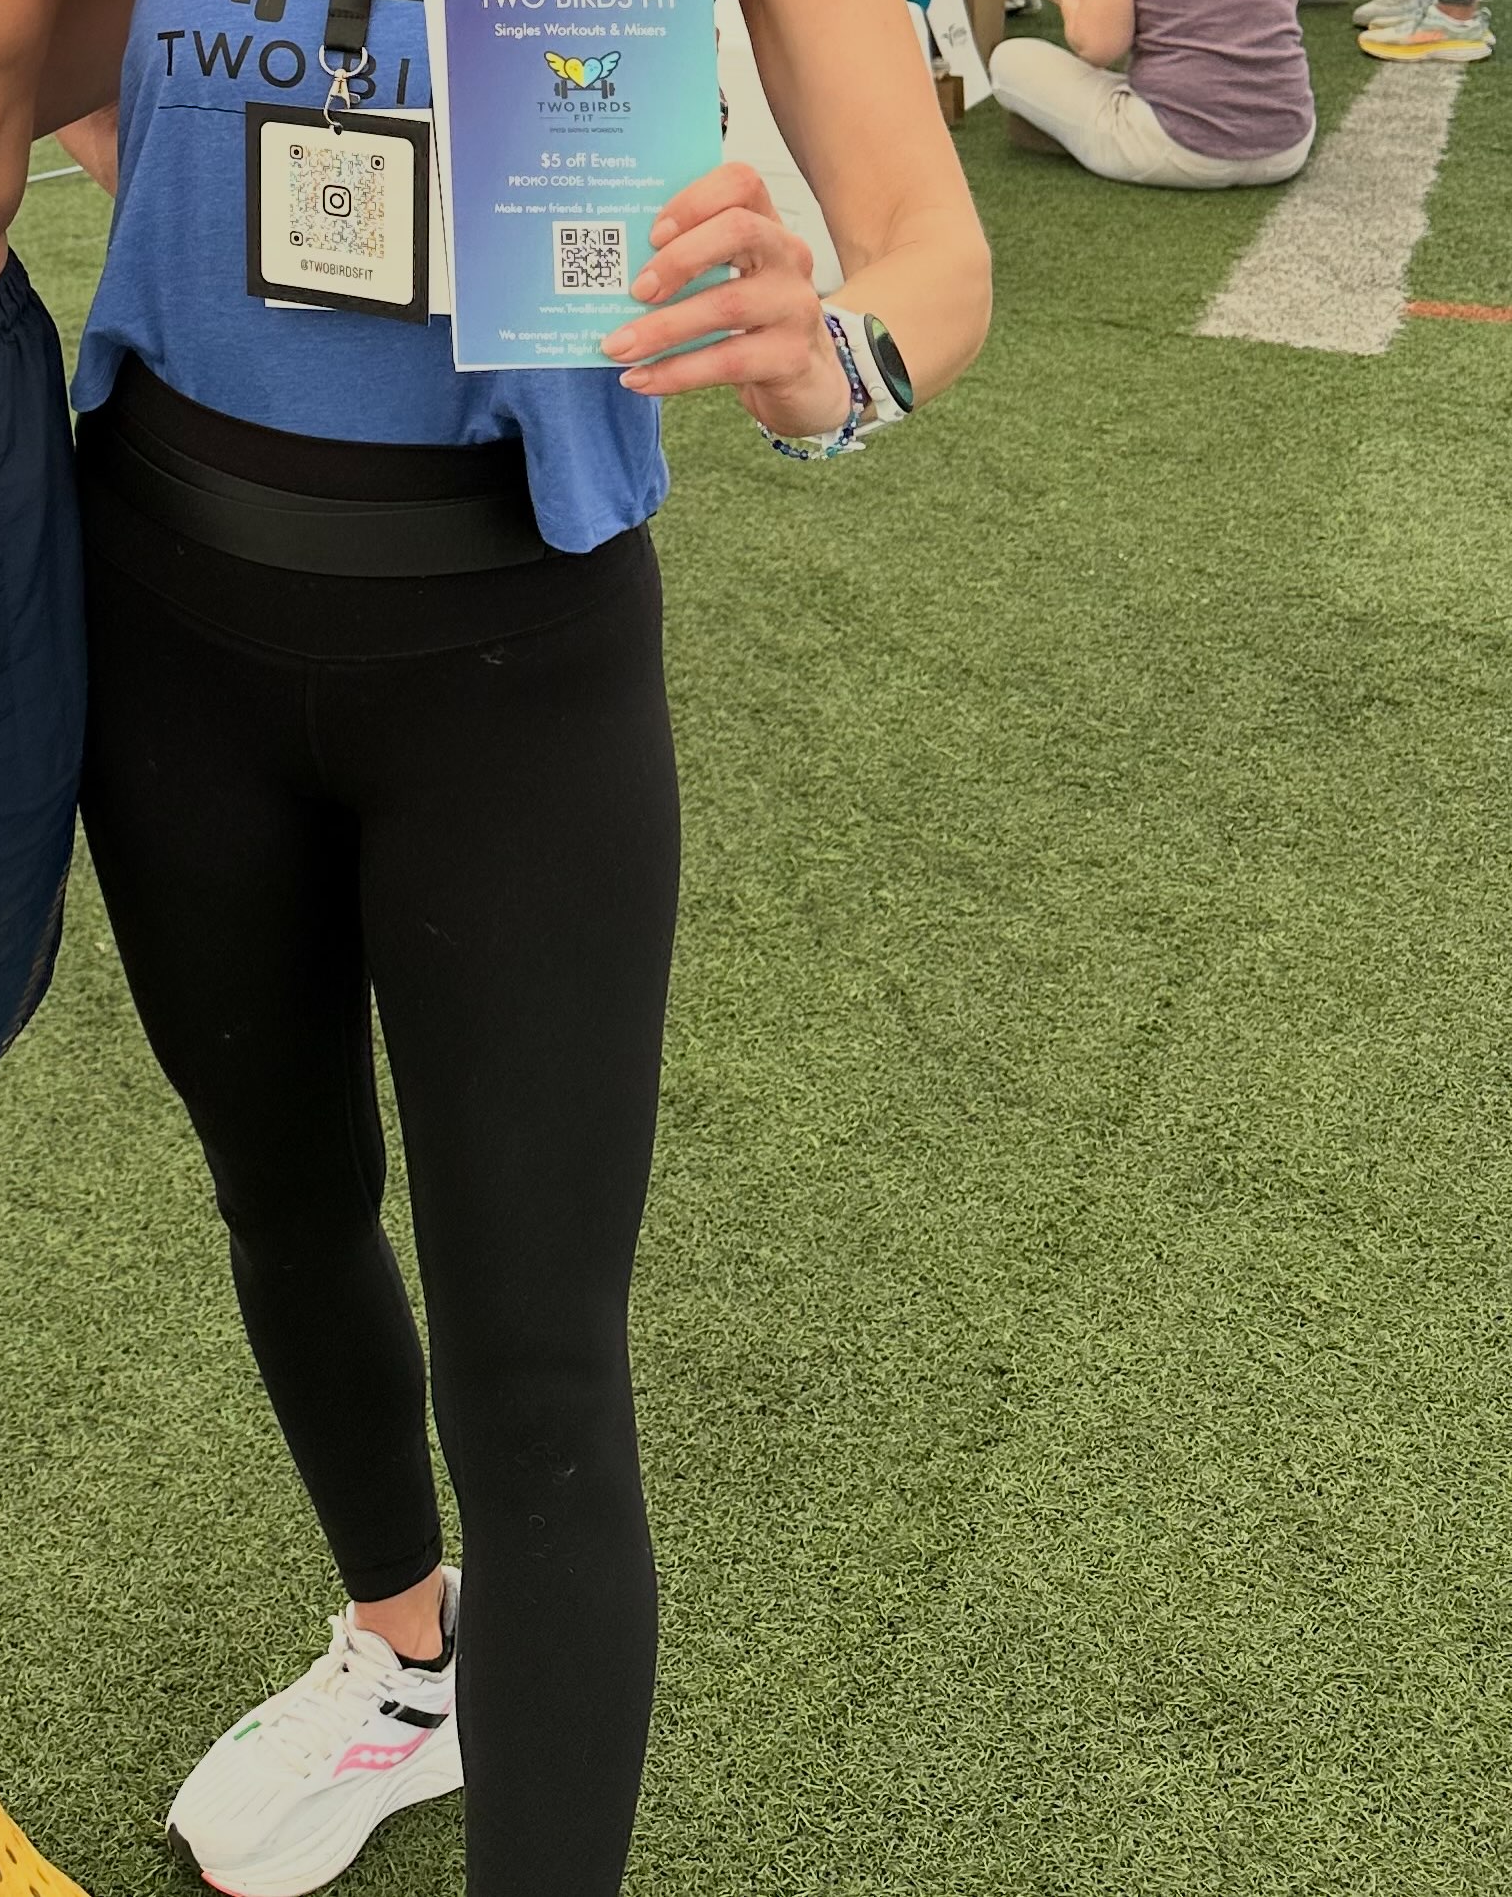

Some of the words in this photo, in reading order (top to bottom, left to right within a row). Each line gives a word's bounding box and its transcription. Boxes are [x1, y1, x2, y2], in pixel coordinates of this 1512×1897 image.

[494, 23, 541, 39] Singles
[544, 23, 606, 36] Workouts
[610, 23, 620, 36] &
[624, 23, 666, 36] Mixers
[157, 30, 306, 89] TWO
[536, 102, 575, 113] TWO
[580, 102, 631, 112] BIRDS
[574, 114, 593, 122] FIT
[541, 152, 561, 168] $5
[566, 153, 586, 167] off
[590, 153, 637, 168] Events
[508, 175, 548, 187] PROMO
[494, 203, 523, 214] Make
[525, 205, 547, 214] new
[549, 203, 583, 214] friends
[300, 258, 374, 281] @TWOBIRDSFIT
[498, 329, 516, 341] We
